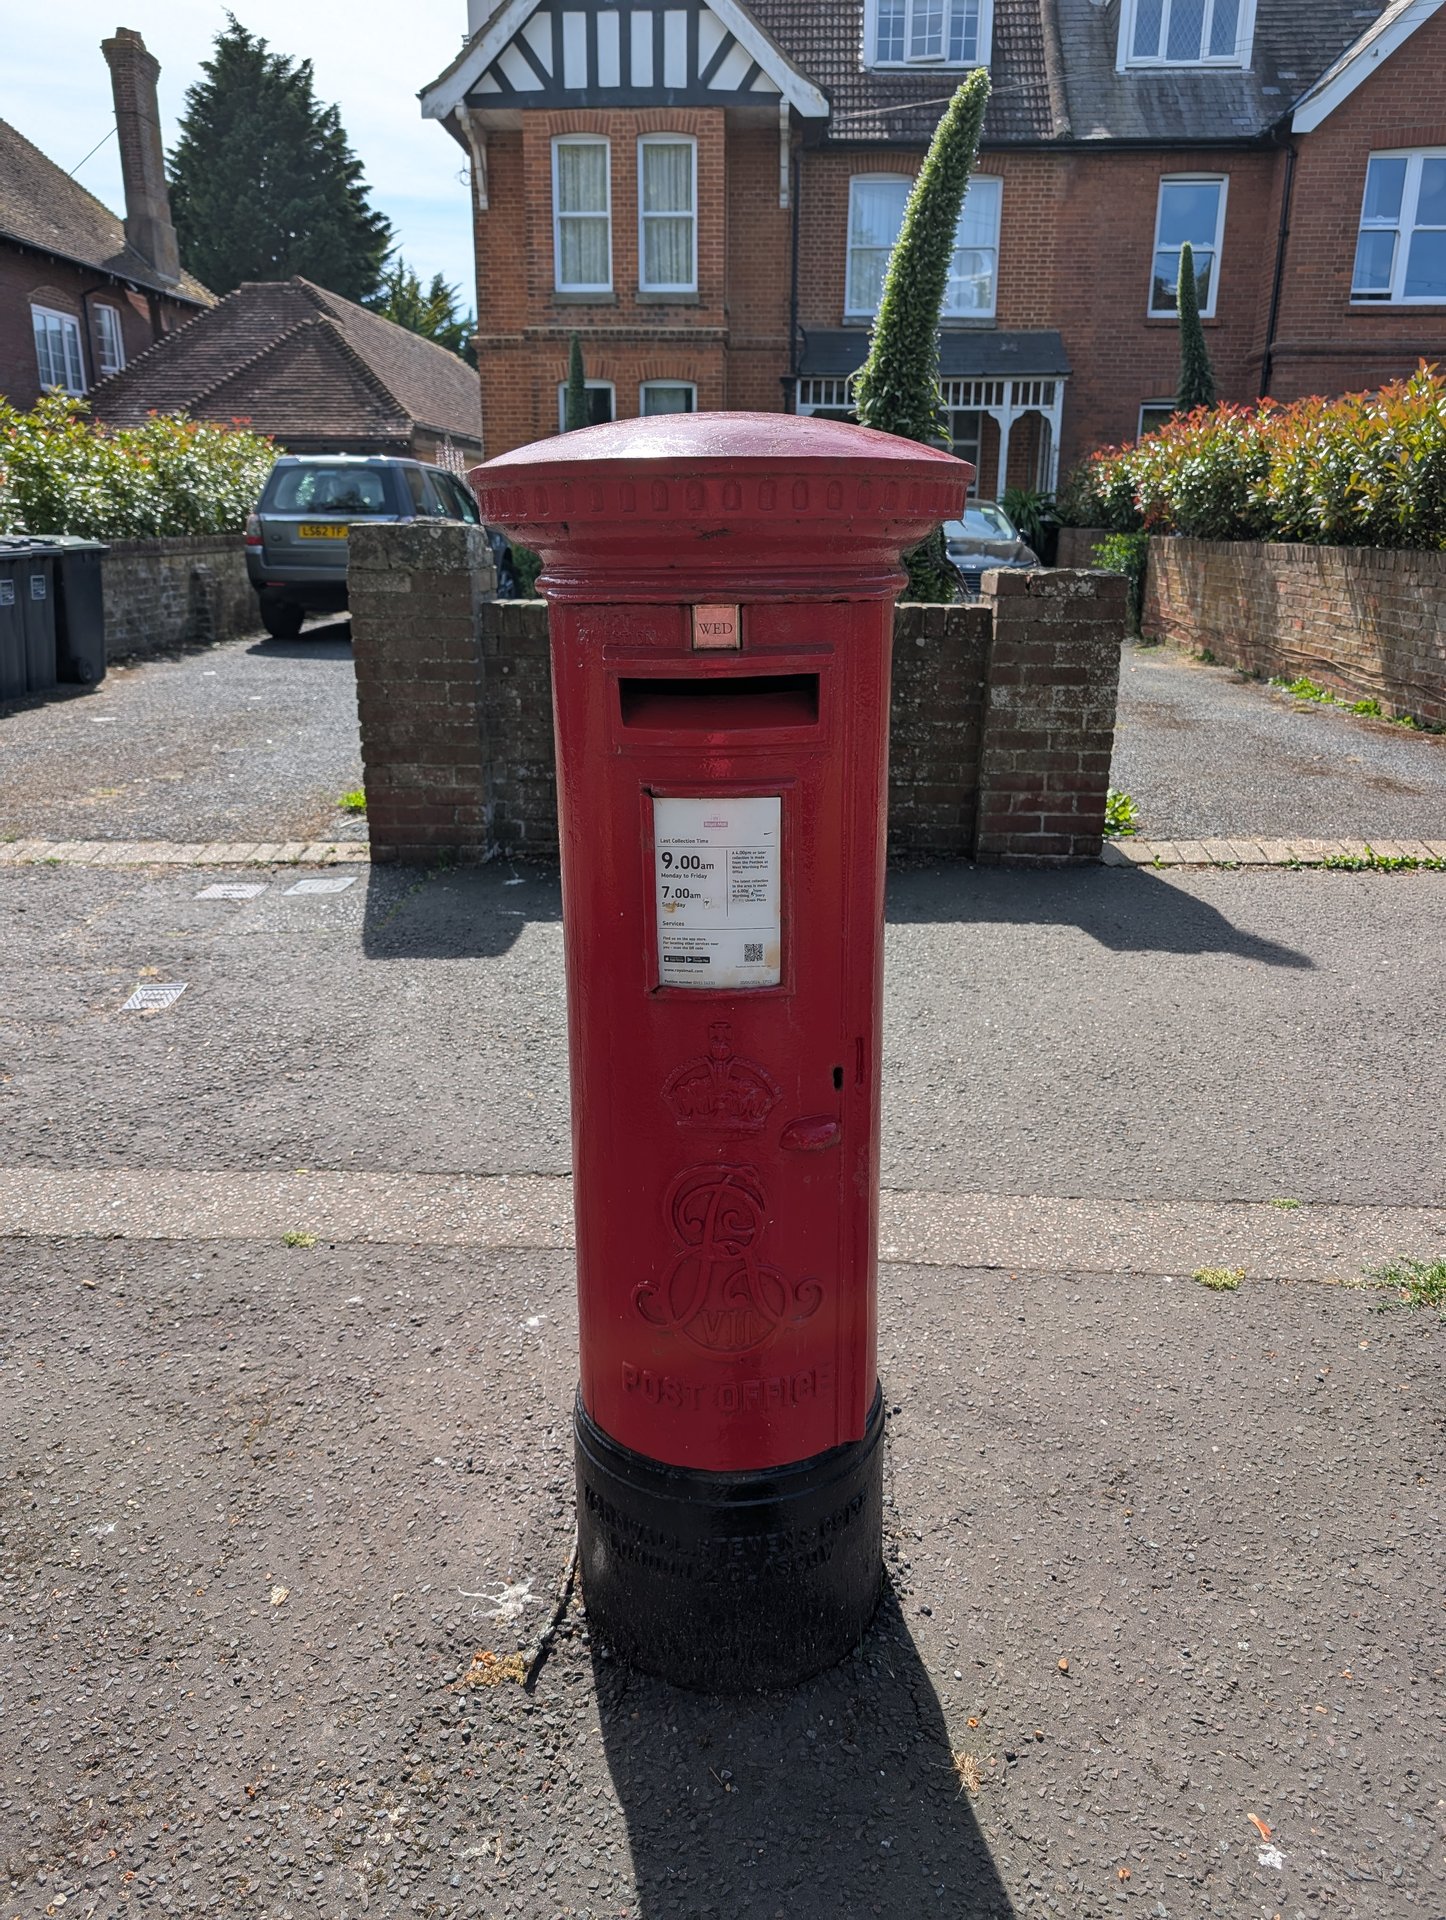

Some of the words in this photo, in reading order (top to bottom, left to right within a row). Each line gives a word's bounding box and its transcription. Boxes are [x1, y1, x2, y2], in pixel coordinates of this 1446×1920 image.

[699, 622, 733, 635] WED
[661, 852, 715, 870] 9.00am
[661, 886, 702, 899] 7.00am
[620, 1360, 708, 1412] POST
[715, 1360, 834, 1413] OFFICE
